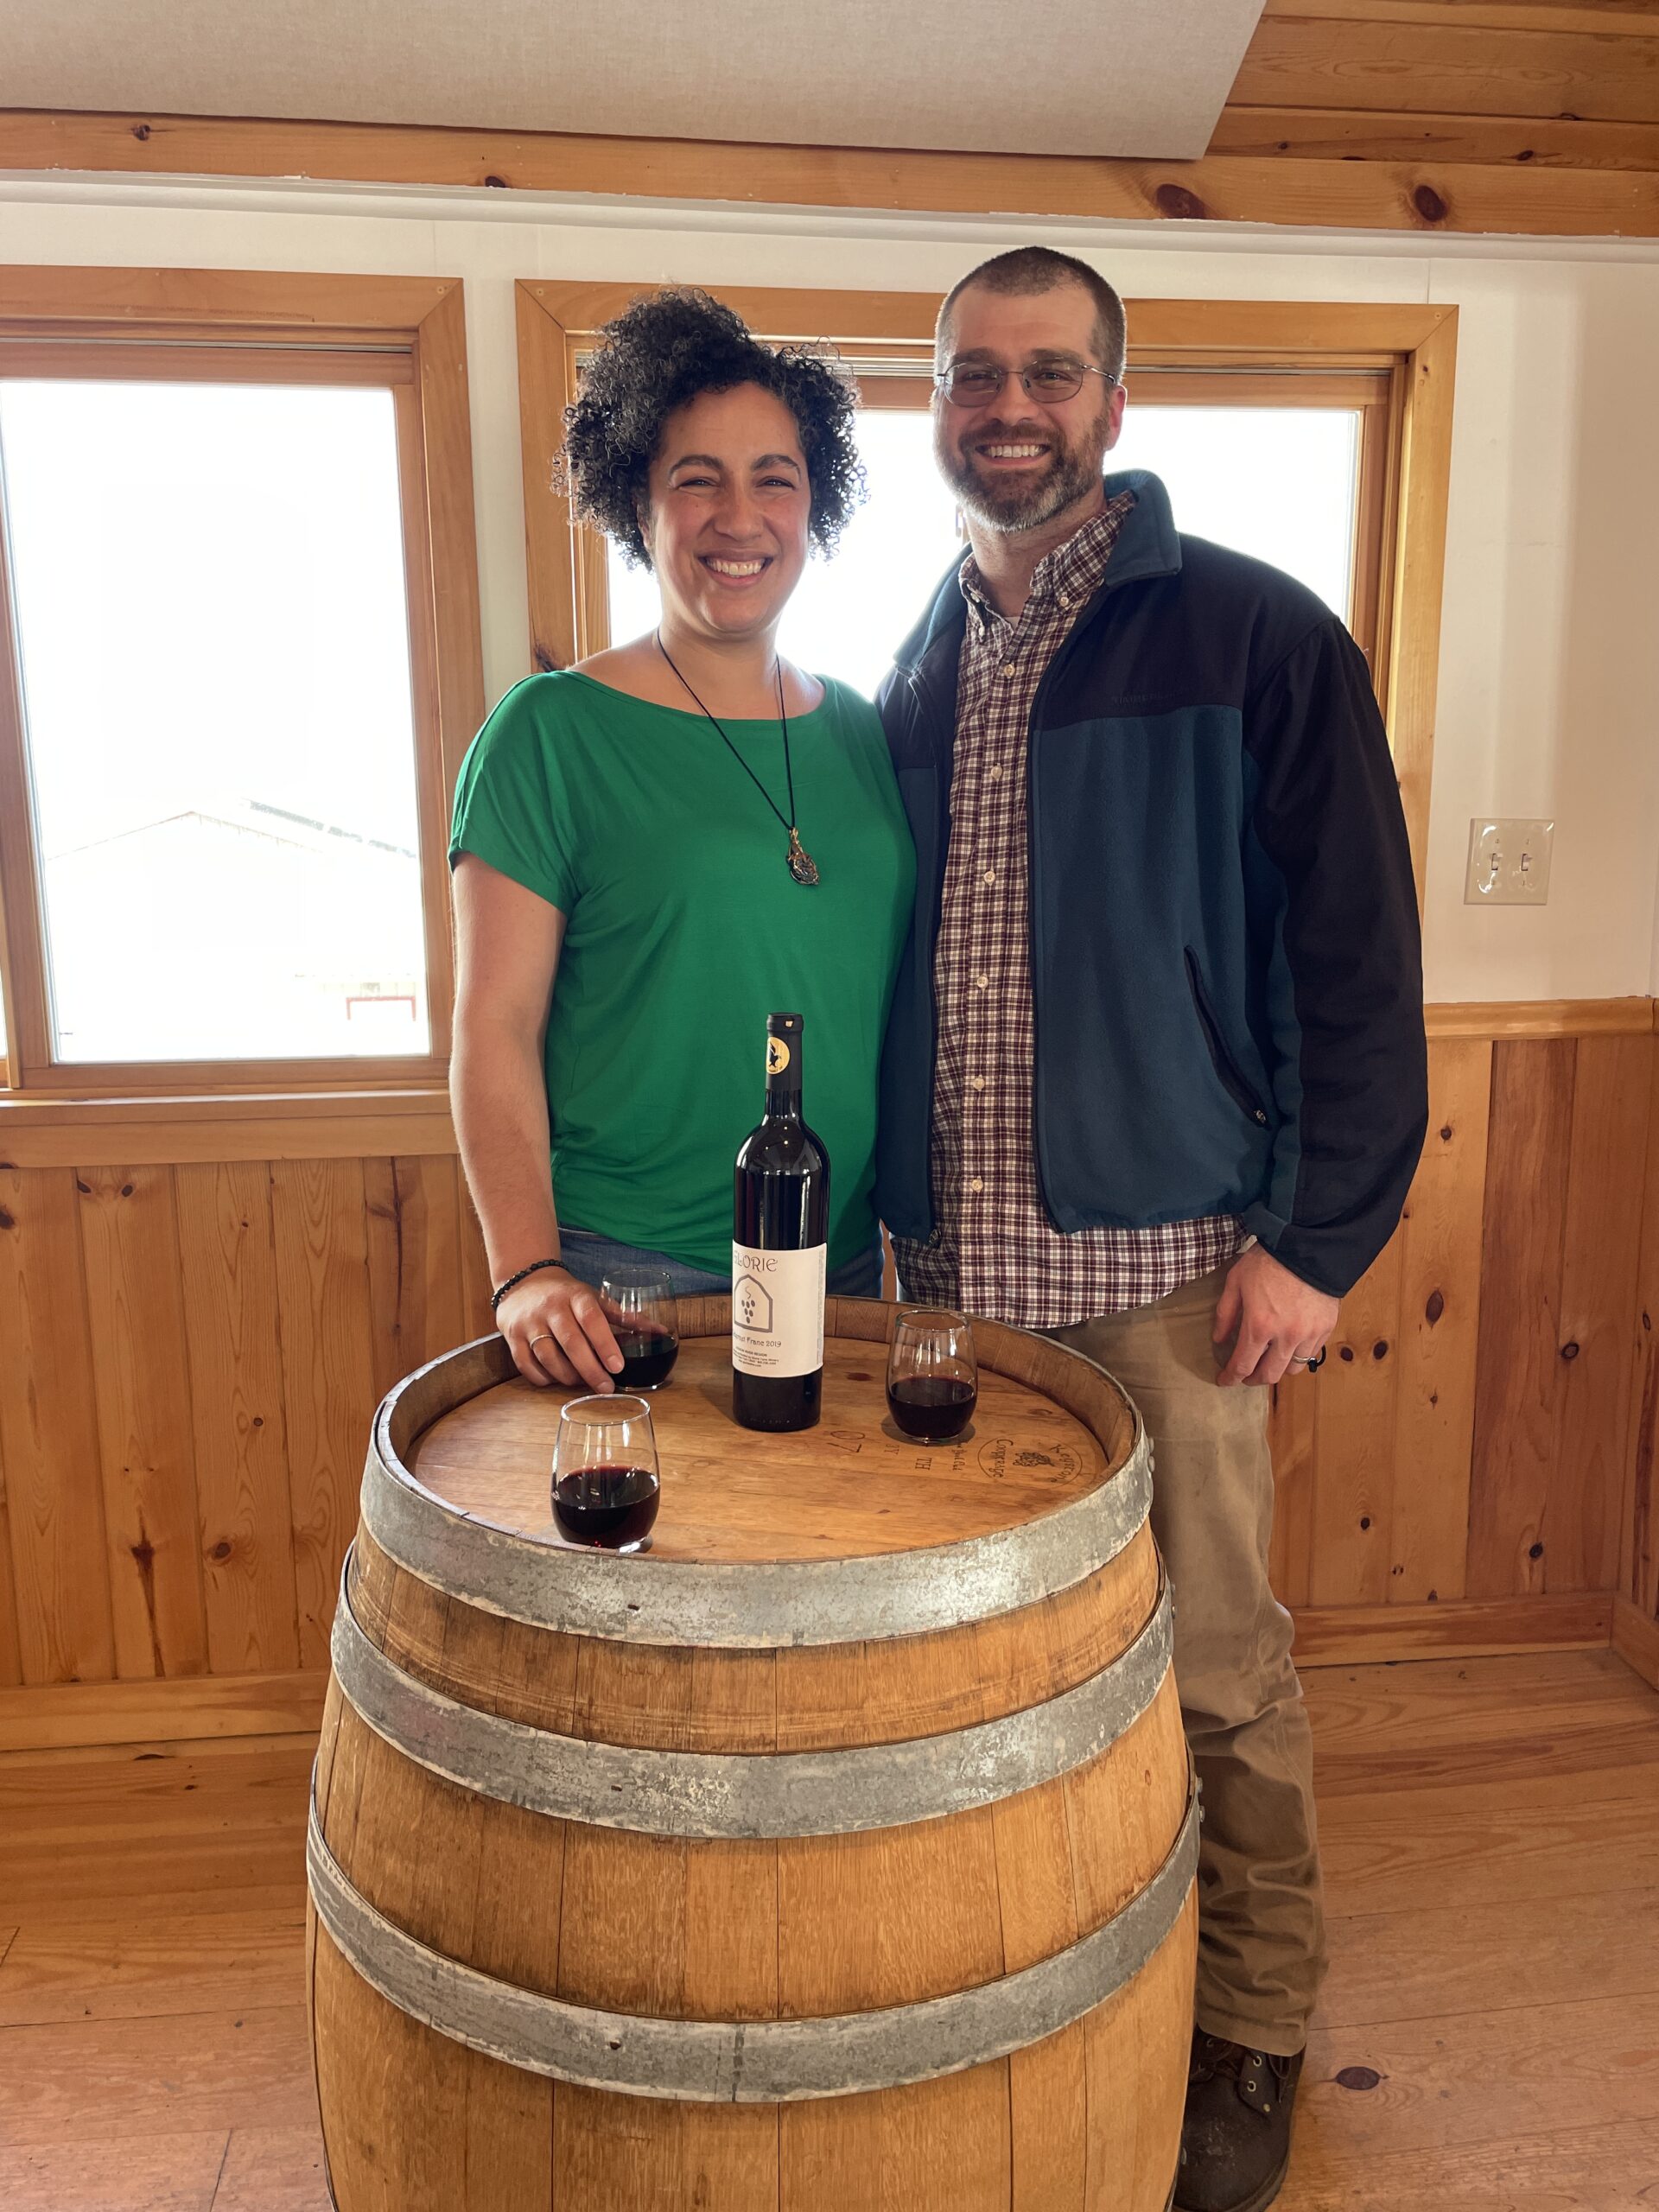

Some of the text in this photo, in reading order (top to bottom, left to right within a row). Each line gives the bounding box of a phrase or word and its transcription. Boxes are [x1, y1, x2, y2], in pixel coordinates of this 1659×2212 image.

[747, 1337, 765, 1346] Franc
[915, 1457, 932, 1471] TH
[1050, 1444, 1076, 1483] Keystone
